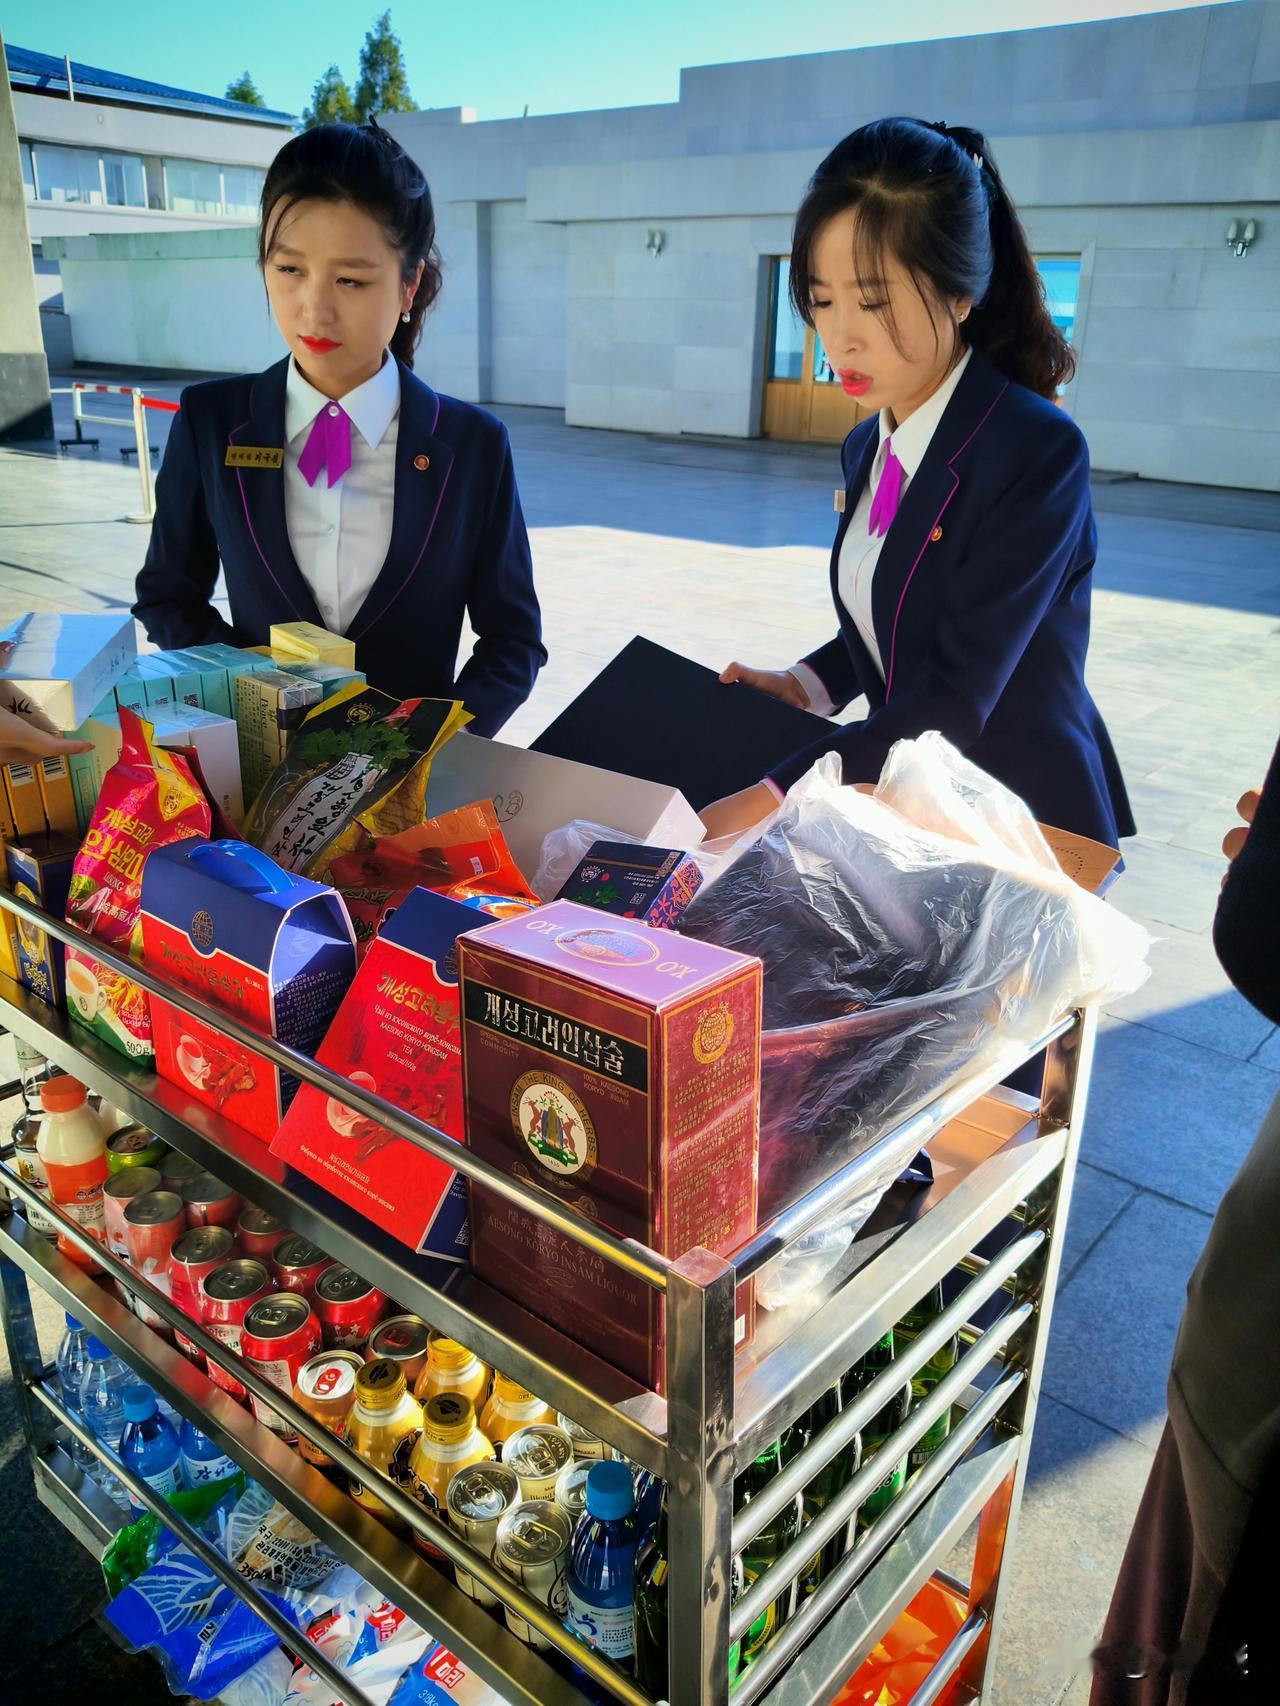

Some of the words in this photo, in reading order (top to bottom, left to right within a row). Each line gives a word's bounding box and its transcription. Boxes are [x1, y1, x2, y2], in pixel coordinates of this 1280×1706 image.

[99, 806, 154, 846] 개성고려
[126, 1040, 151, 1056] 500g
[402, 1044, 413, 1056] TEA
[483, 991, 625, 1076] 개성고려인삼술
[523, 1073, 539, 1086] THE
[543, 1074, 566, 1092] KING
[568, 1091, 580, 1106] OF
[579, 1107, 597, 1153] HERBS
[486, 1215, 524, 1244] AESONG
[526, 1235, 559, 1263] KORYO
[561, 1257, 595, 1283] INSAM
[596, 1274, 639, 1306] LIQUOR
